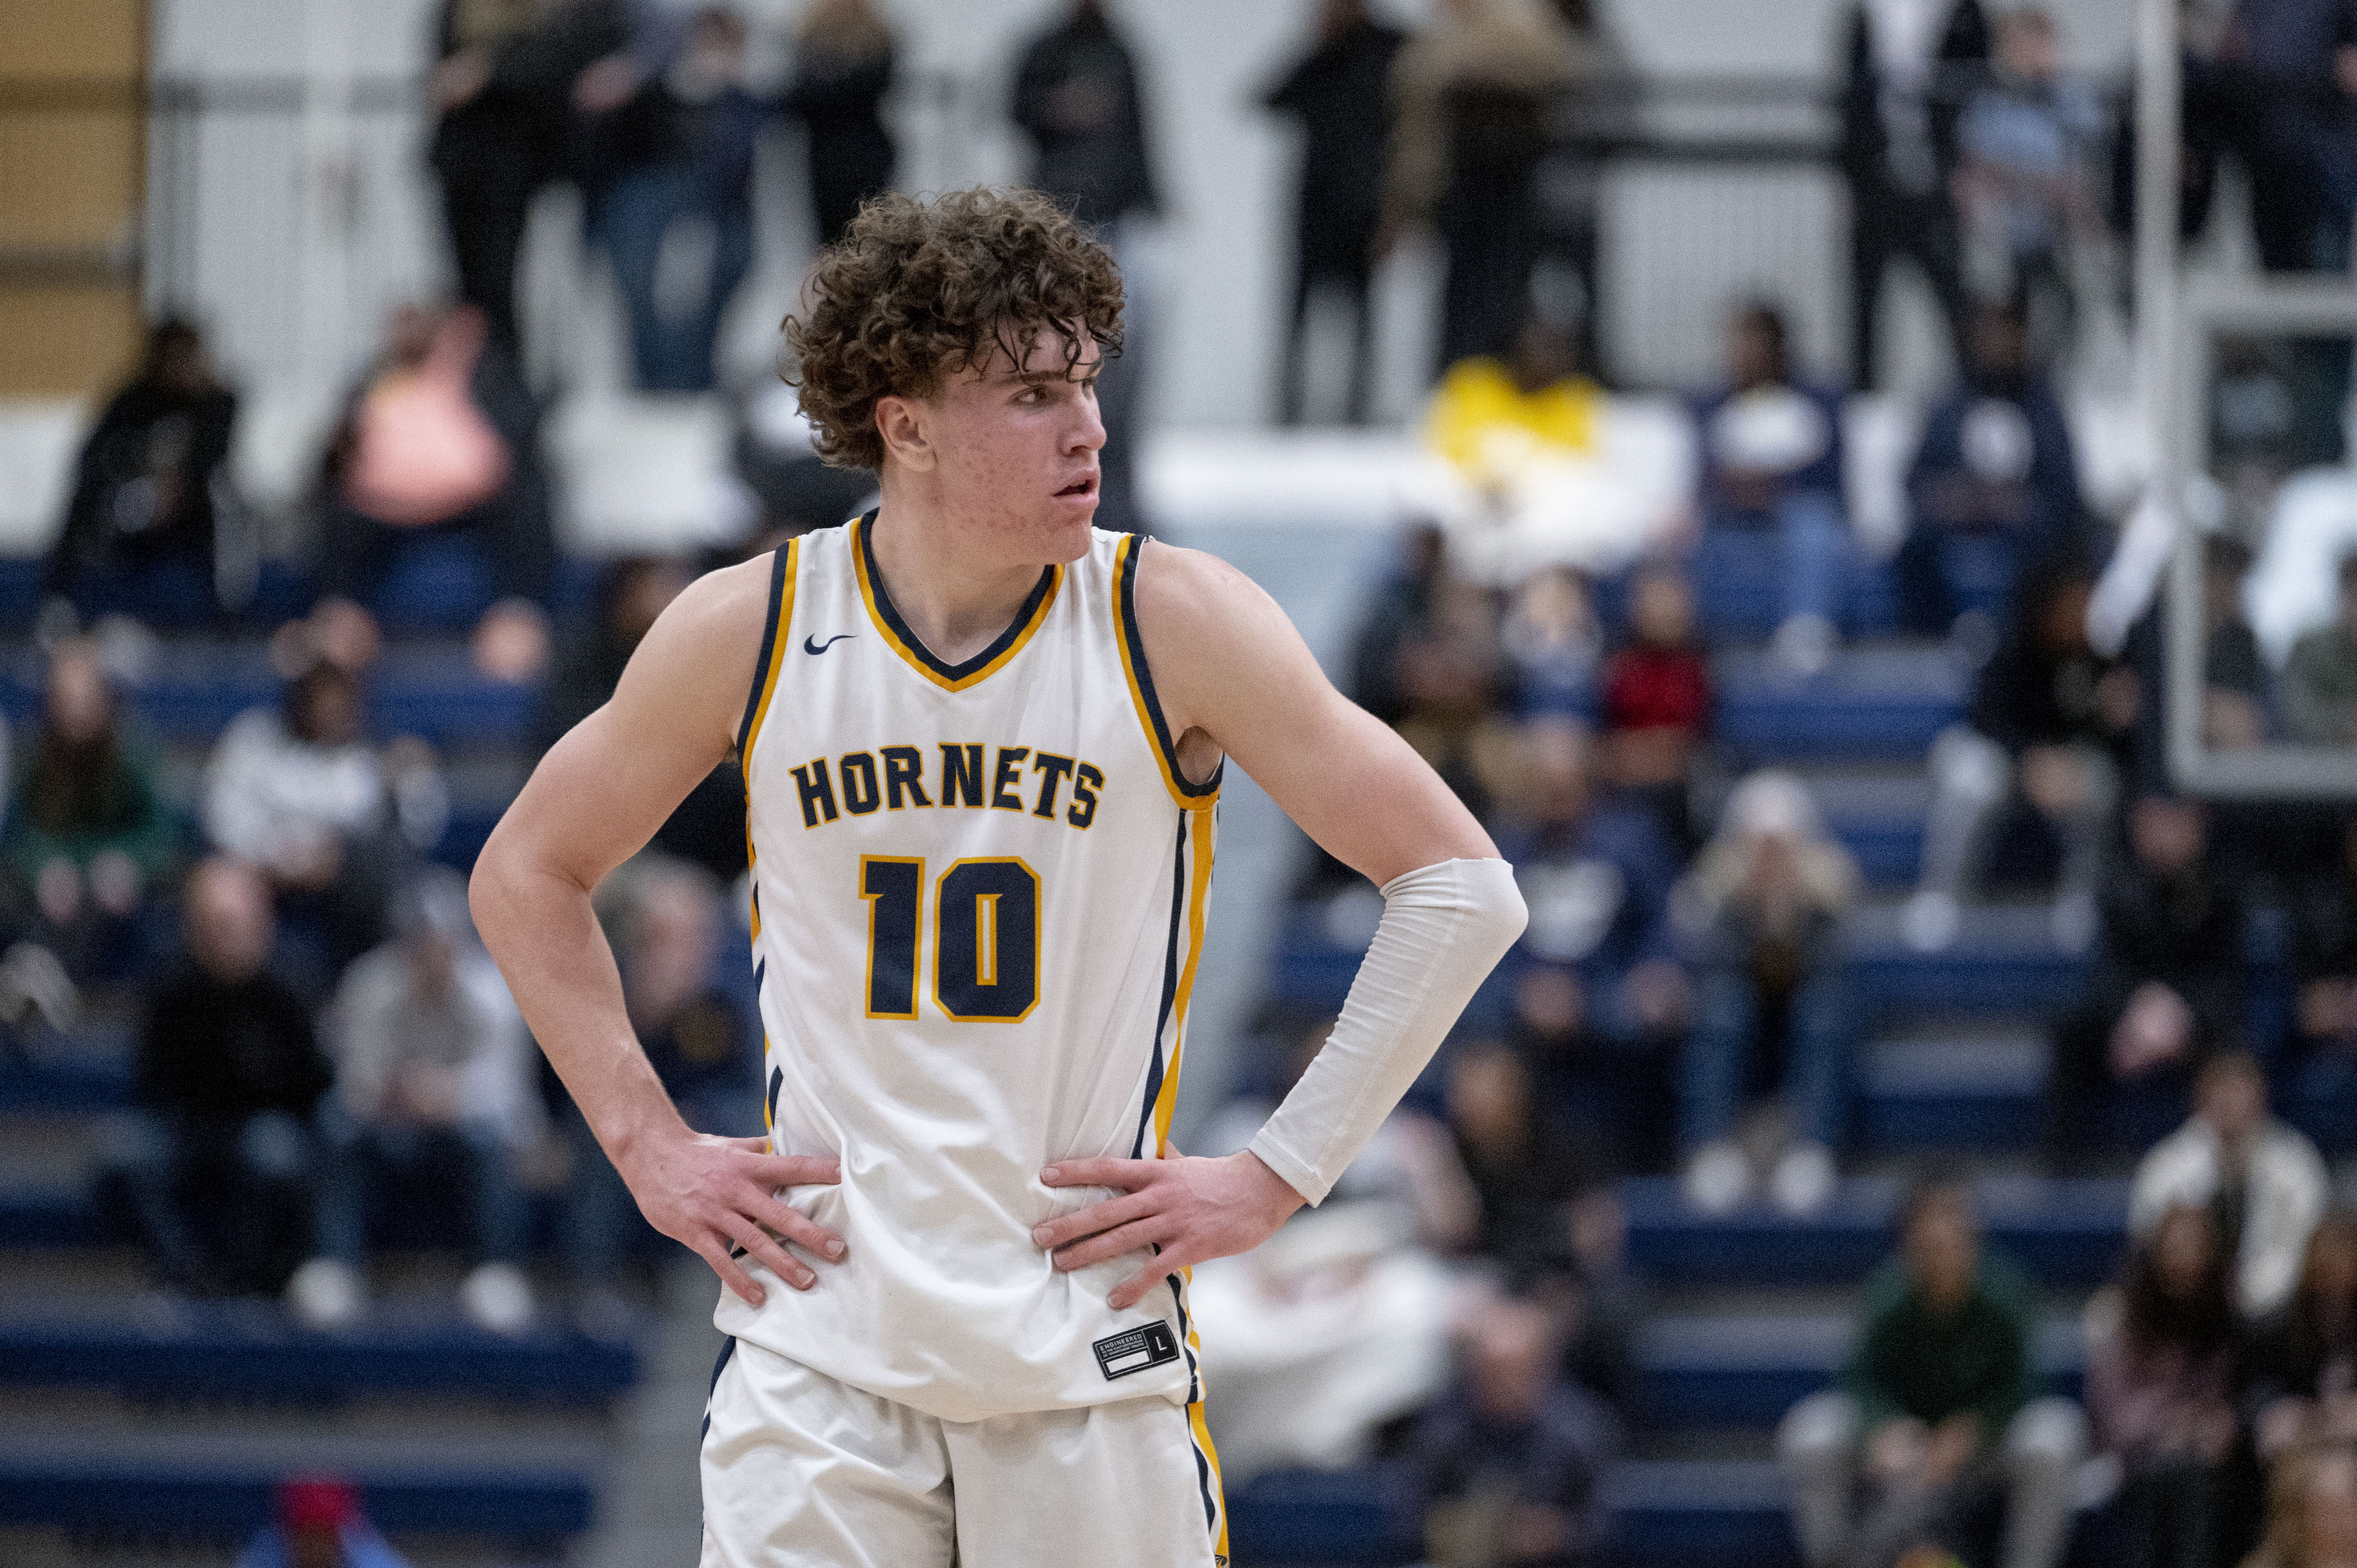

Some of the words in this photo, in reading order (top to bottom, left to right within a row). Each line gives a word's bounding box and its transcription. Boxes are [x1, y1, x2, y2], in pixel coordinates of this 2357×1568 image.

[788, 742, 1105, 831] HORNETS
[858, 854, 1042, 1024] 10
[1099, 1333, 1142, 1351] ENGINEERED
[1156, 1336, 1168, 1351] L
